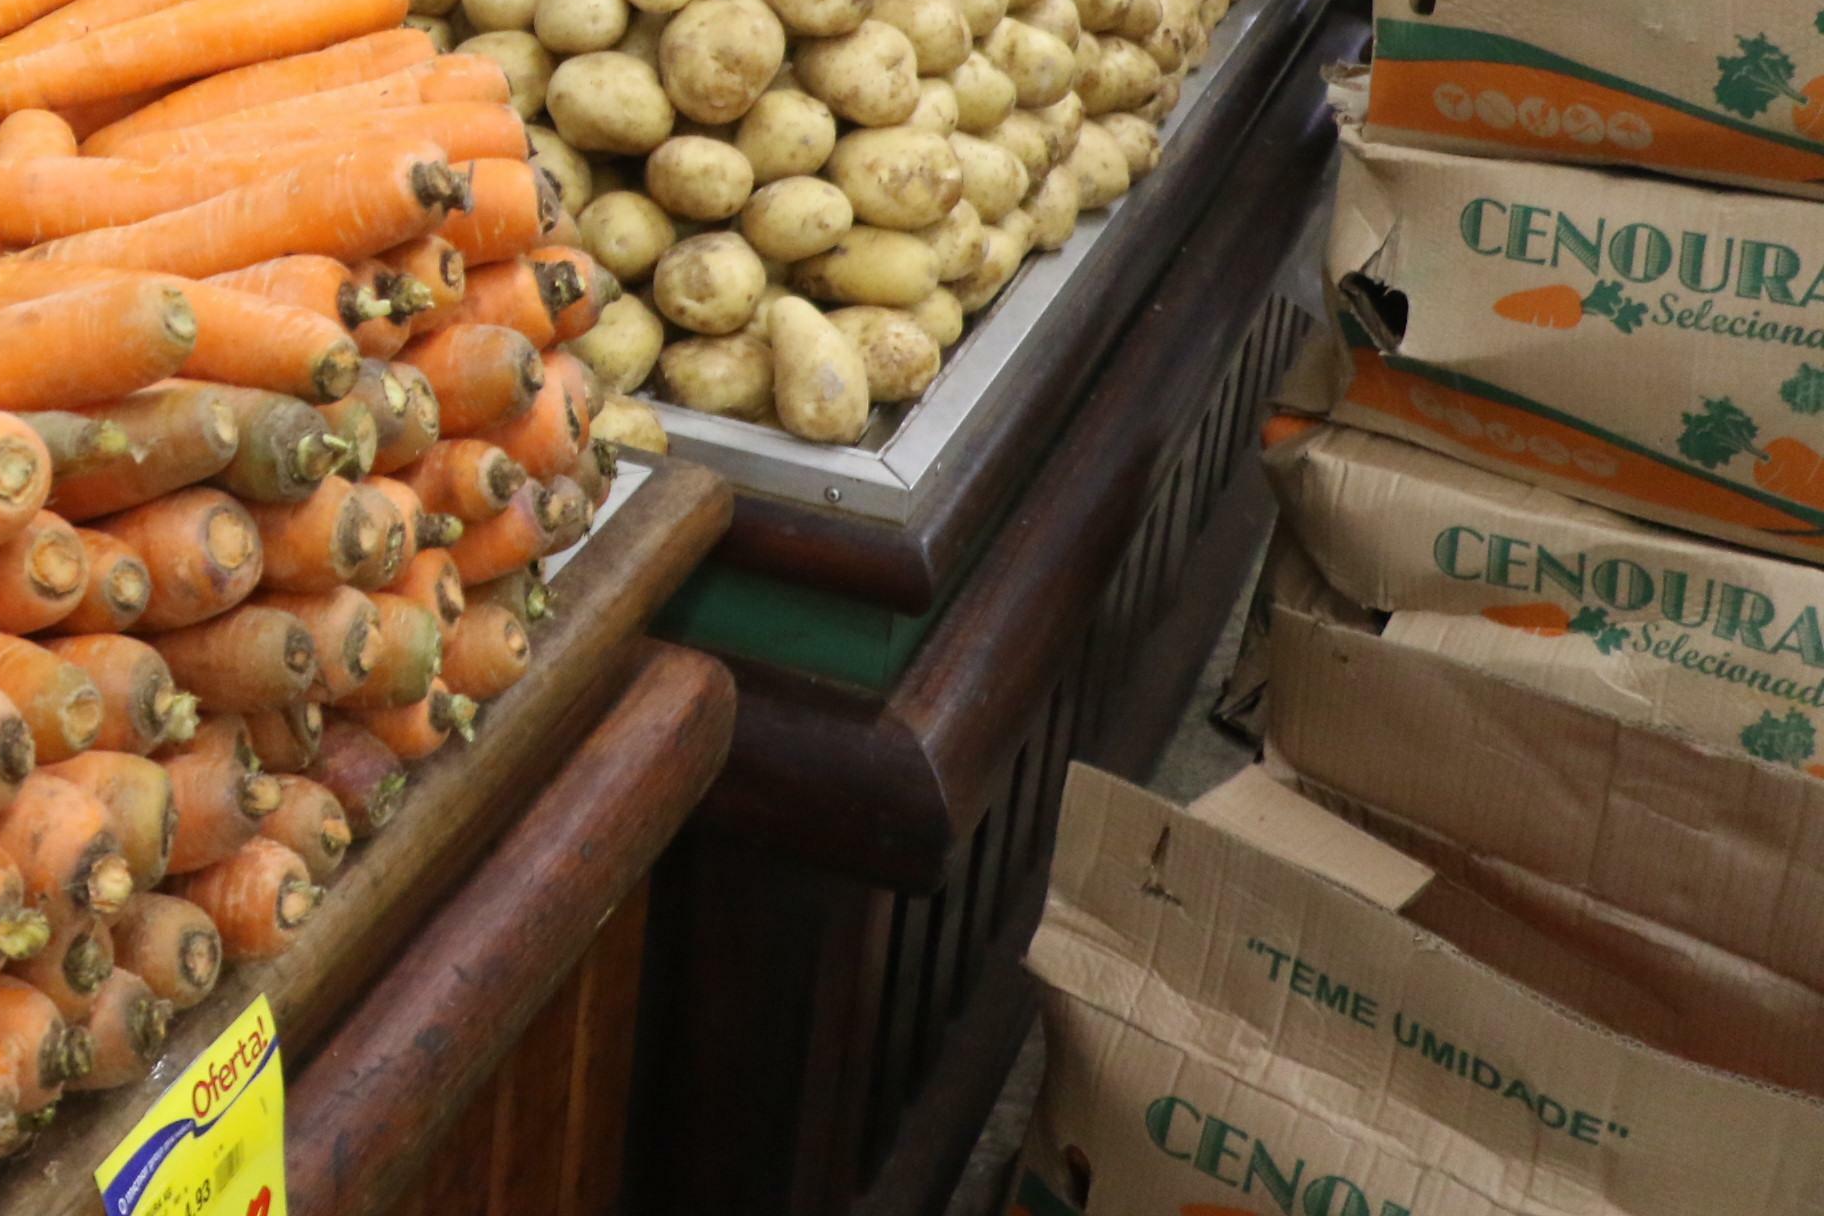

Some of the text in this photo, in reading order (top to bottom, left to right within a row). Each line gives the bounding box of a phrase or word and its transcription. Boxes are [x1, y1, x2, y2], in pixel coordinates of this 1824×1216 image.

[1433, 526, 1824, 669] CENOURA
[192, 1015, 268, 1119] Oferta!
[1247, 937, 1630, 1146] "TEME UMIDADE"
[1145, 1096, 1412, 1216] CENO
